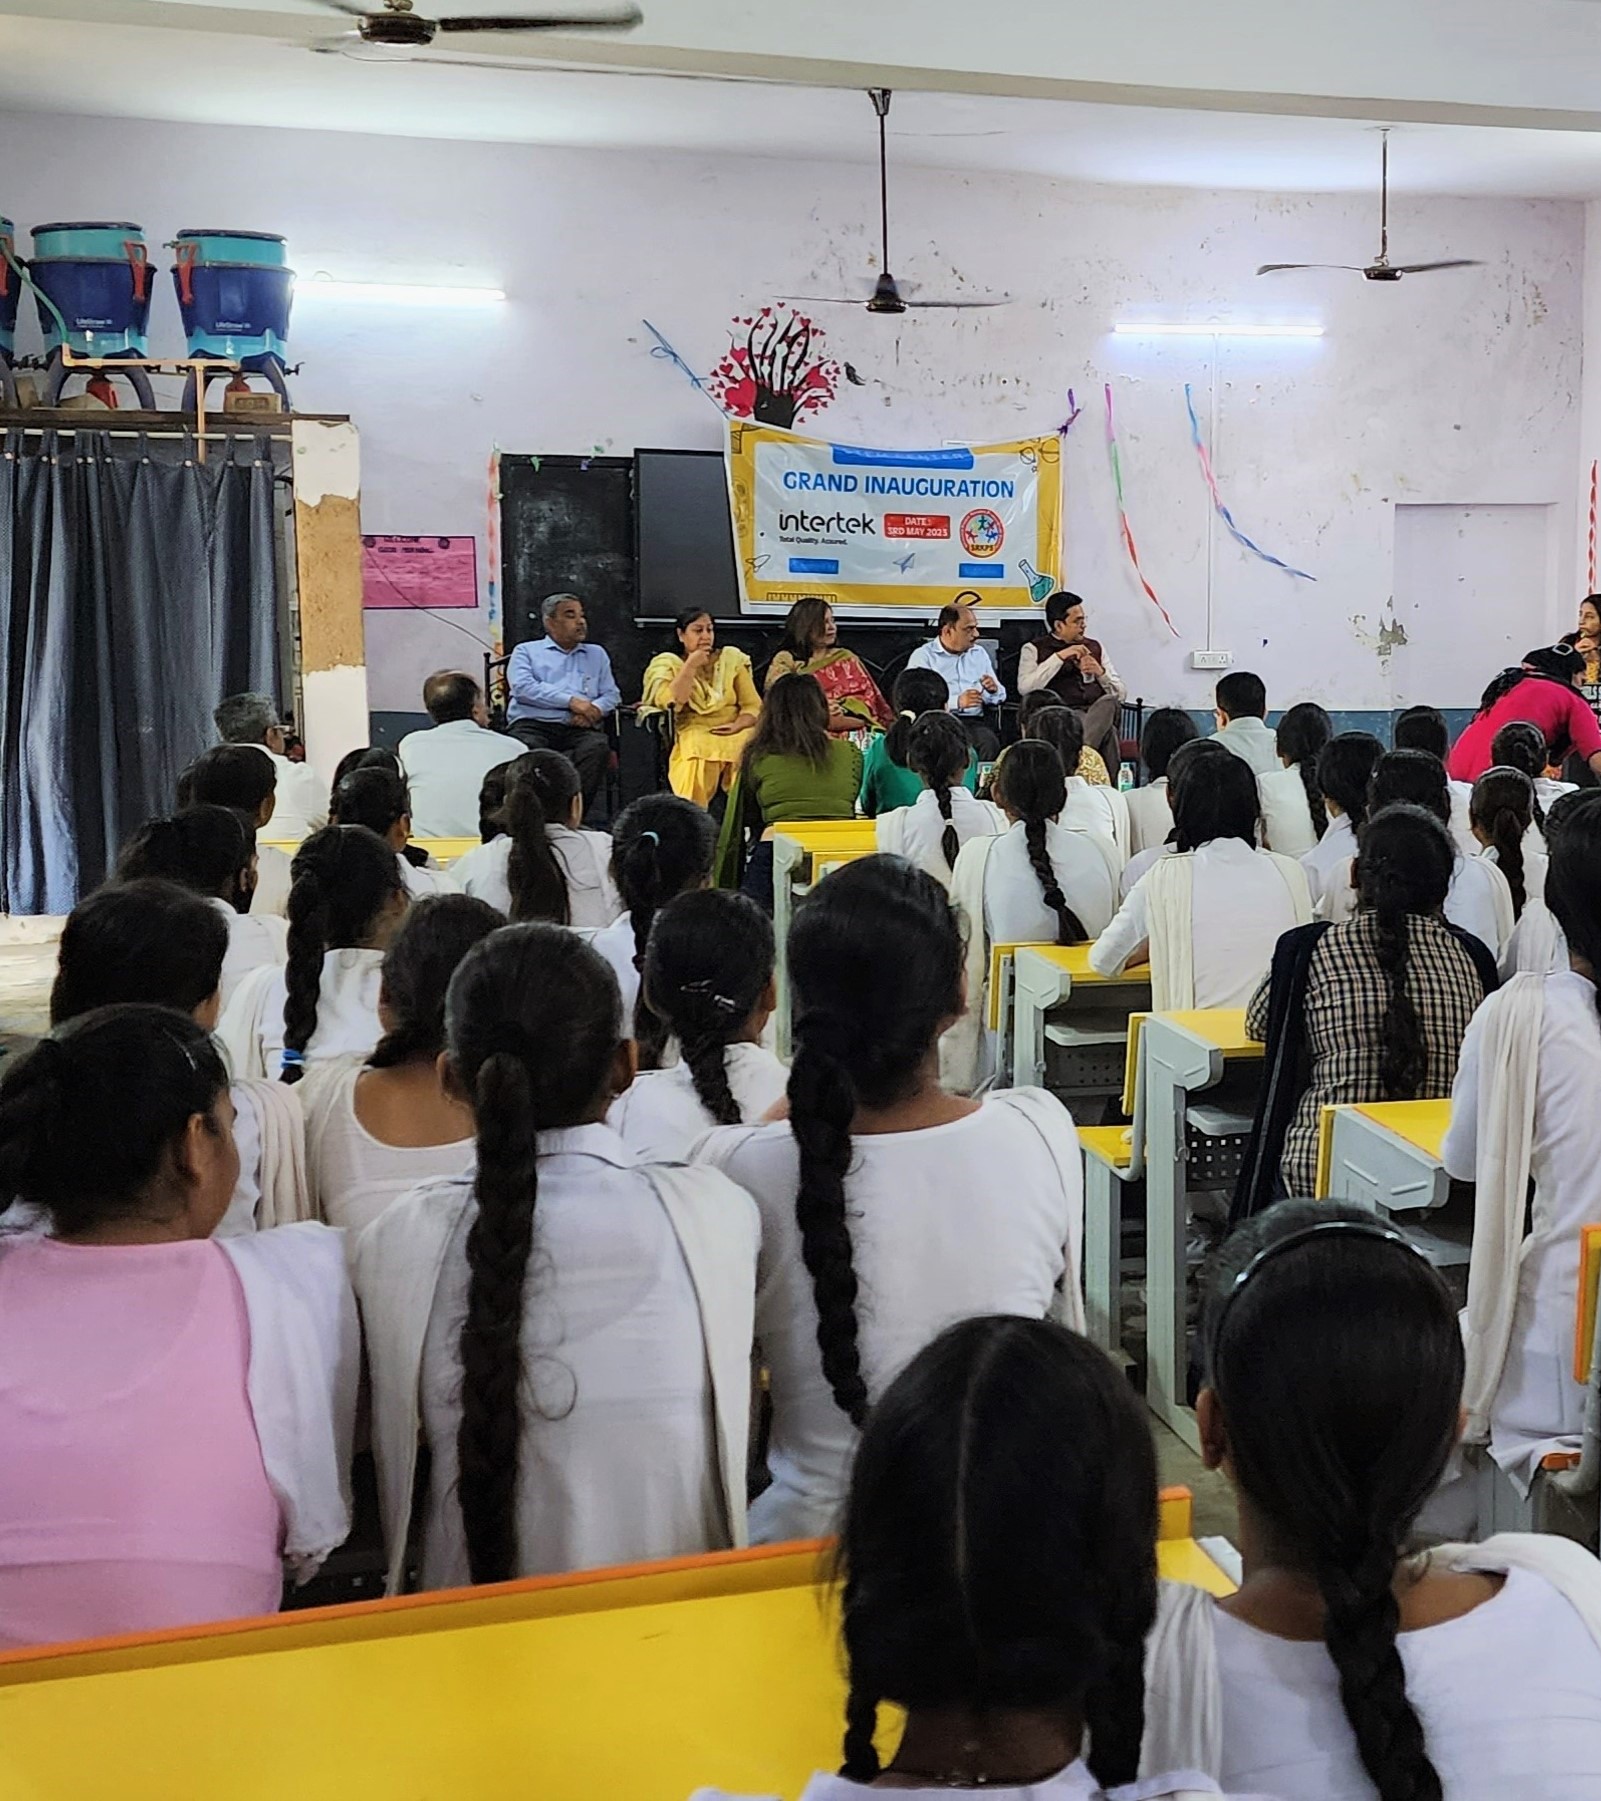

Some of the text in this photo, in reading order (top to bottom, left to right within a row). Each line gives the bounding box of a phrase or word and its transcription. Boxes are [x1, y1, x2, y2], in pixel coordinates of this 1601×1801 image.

[783, 471, 1014, 498] GRAND INAUGURATION
[779, 509, 876, 535] intertek
[887, 527, 905, 536] 3RD
[906, 527, 925, 536] MAY
